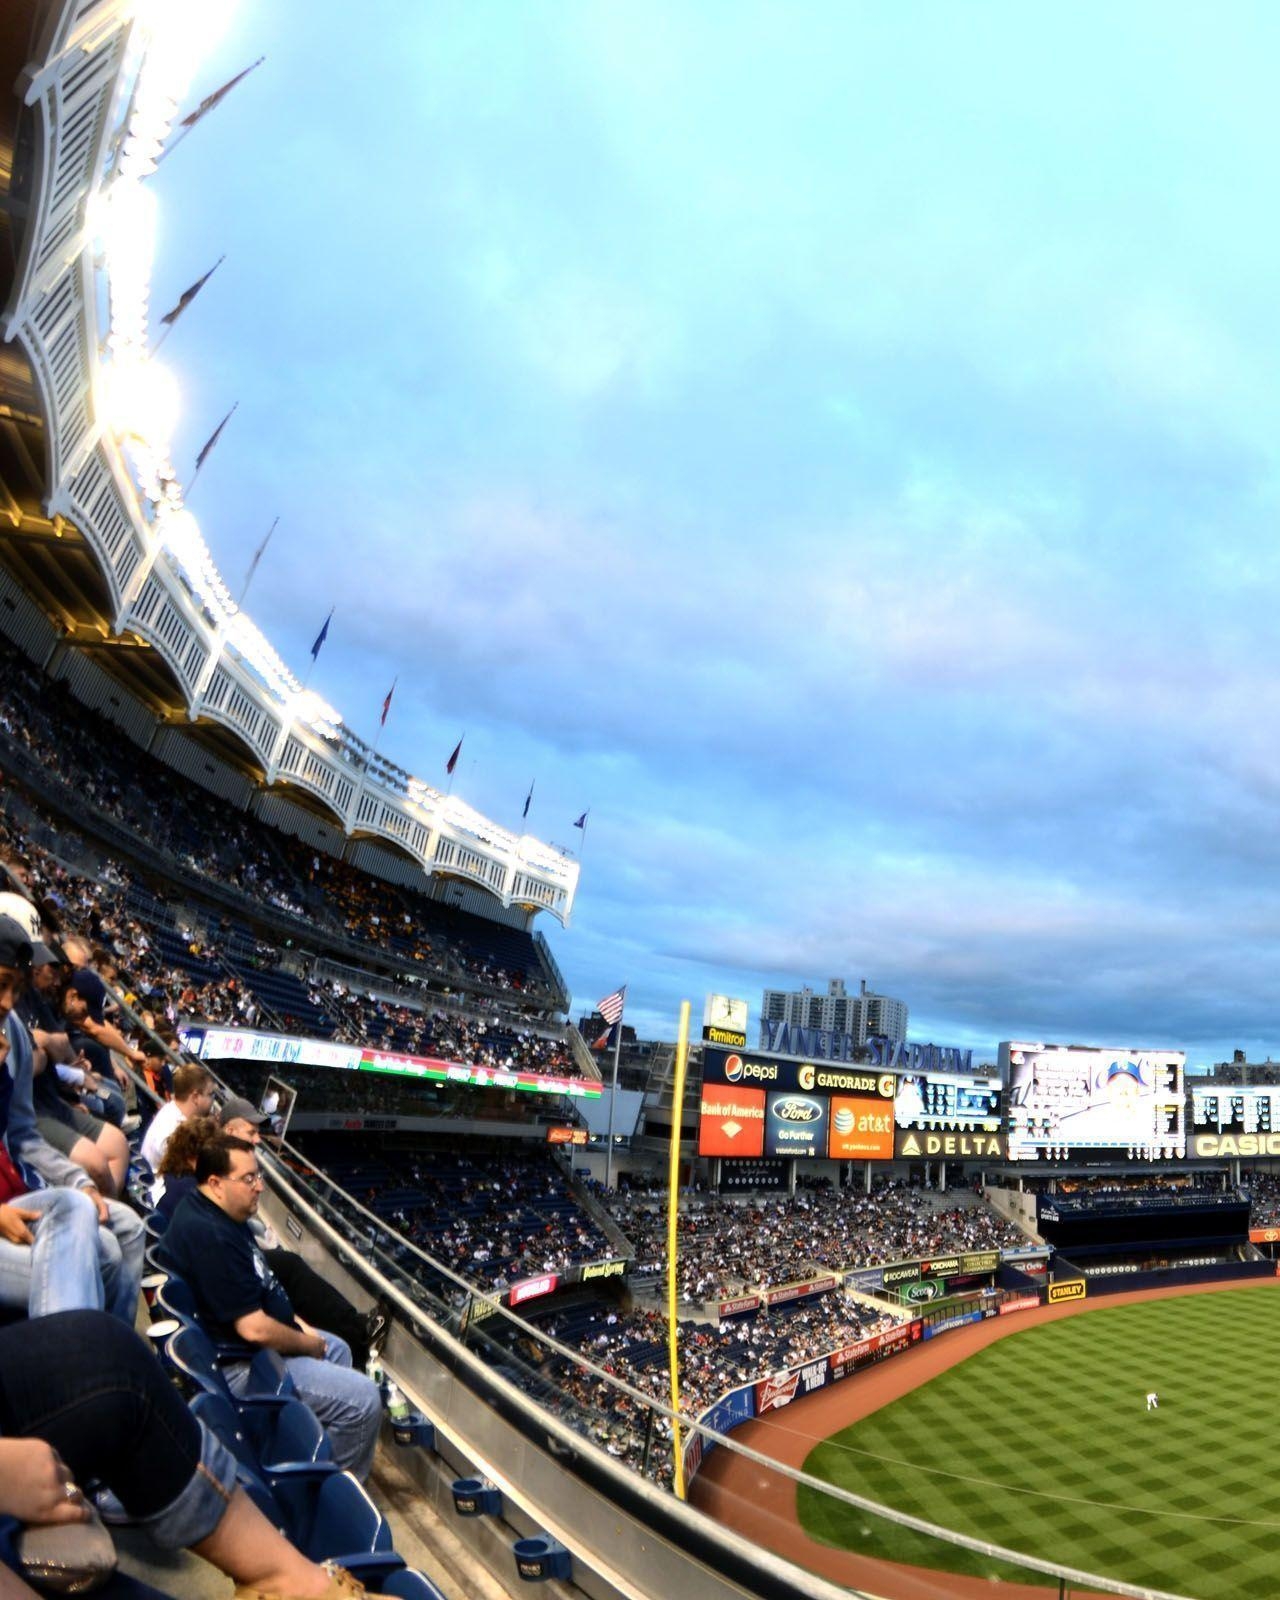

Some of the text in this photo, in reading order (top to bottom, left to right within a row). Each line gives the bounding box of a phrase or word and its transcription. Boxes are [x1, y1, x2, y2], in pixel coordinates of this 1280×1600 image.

[709, 1028, 745, 1047] Armitron
[761, 1018, 973, 1073] YANKEE STADIUM
[743, 1063, 778, 1081] pepsi
[817, 1073, 876, 1091] GATORADE
[701, 1102, 764, 1119] Bank of America
[781, 1101, 812, 1121] Ford
[857, 1115, 890, 1133] at&t
[927, 1136, 1001, 1156] DELTA
[889, 1267, 918, 1281] ROCAWEAR
[929, 1259, 959, 1272] YOKOHAMA
[1052, 1284, 1082, 1298] STANLEY
[801, 1360, 828, 1381] WALK-OFF
[761, 1379, 796, 1400] Budweiser
[810, 1374, 825, 1390] HERO
